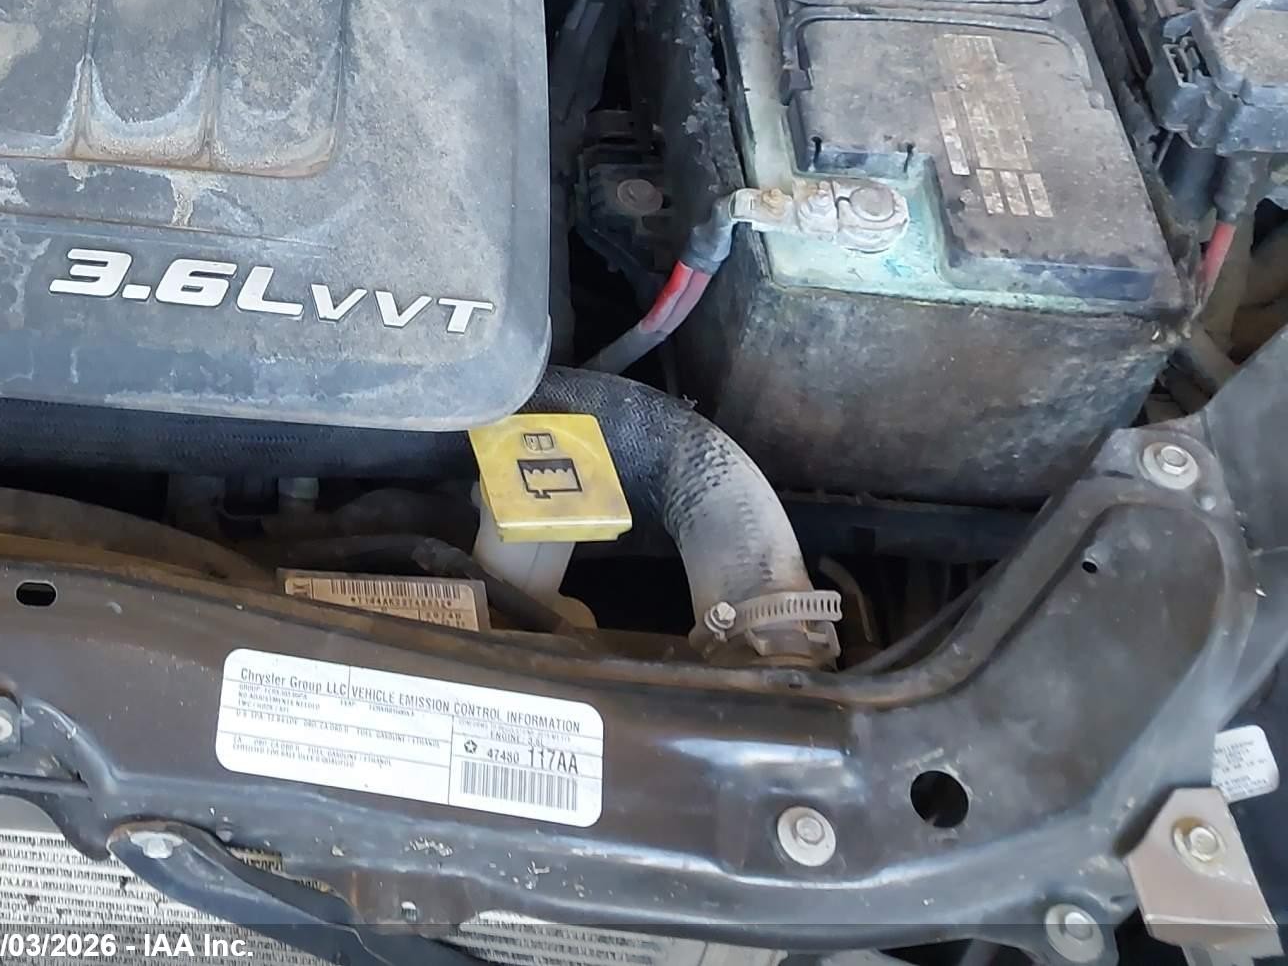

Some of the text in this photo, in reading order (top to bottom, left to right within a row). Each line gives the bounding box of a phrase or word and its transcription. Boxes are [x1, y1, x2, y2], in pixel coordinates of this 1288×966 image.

[49, 247, 495, 334] 3.6L VVT
[241, 667, 285, 685] Chrysler
[290, 675, 322, 695] Group
[326, 682, 347, 696] LLC
[352, 685, 395, 704] VEHICLE
[399, 692, 449, 712] EMISSION
[454, 702, 501, 721] CONTROL
[507, 711, 580, 733] INFORMATION
[529, 746, 579, 775] 117AA
